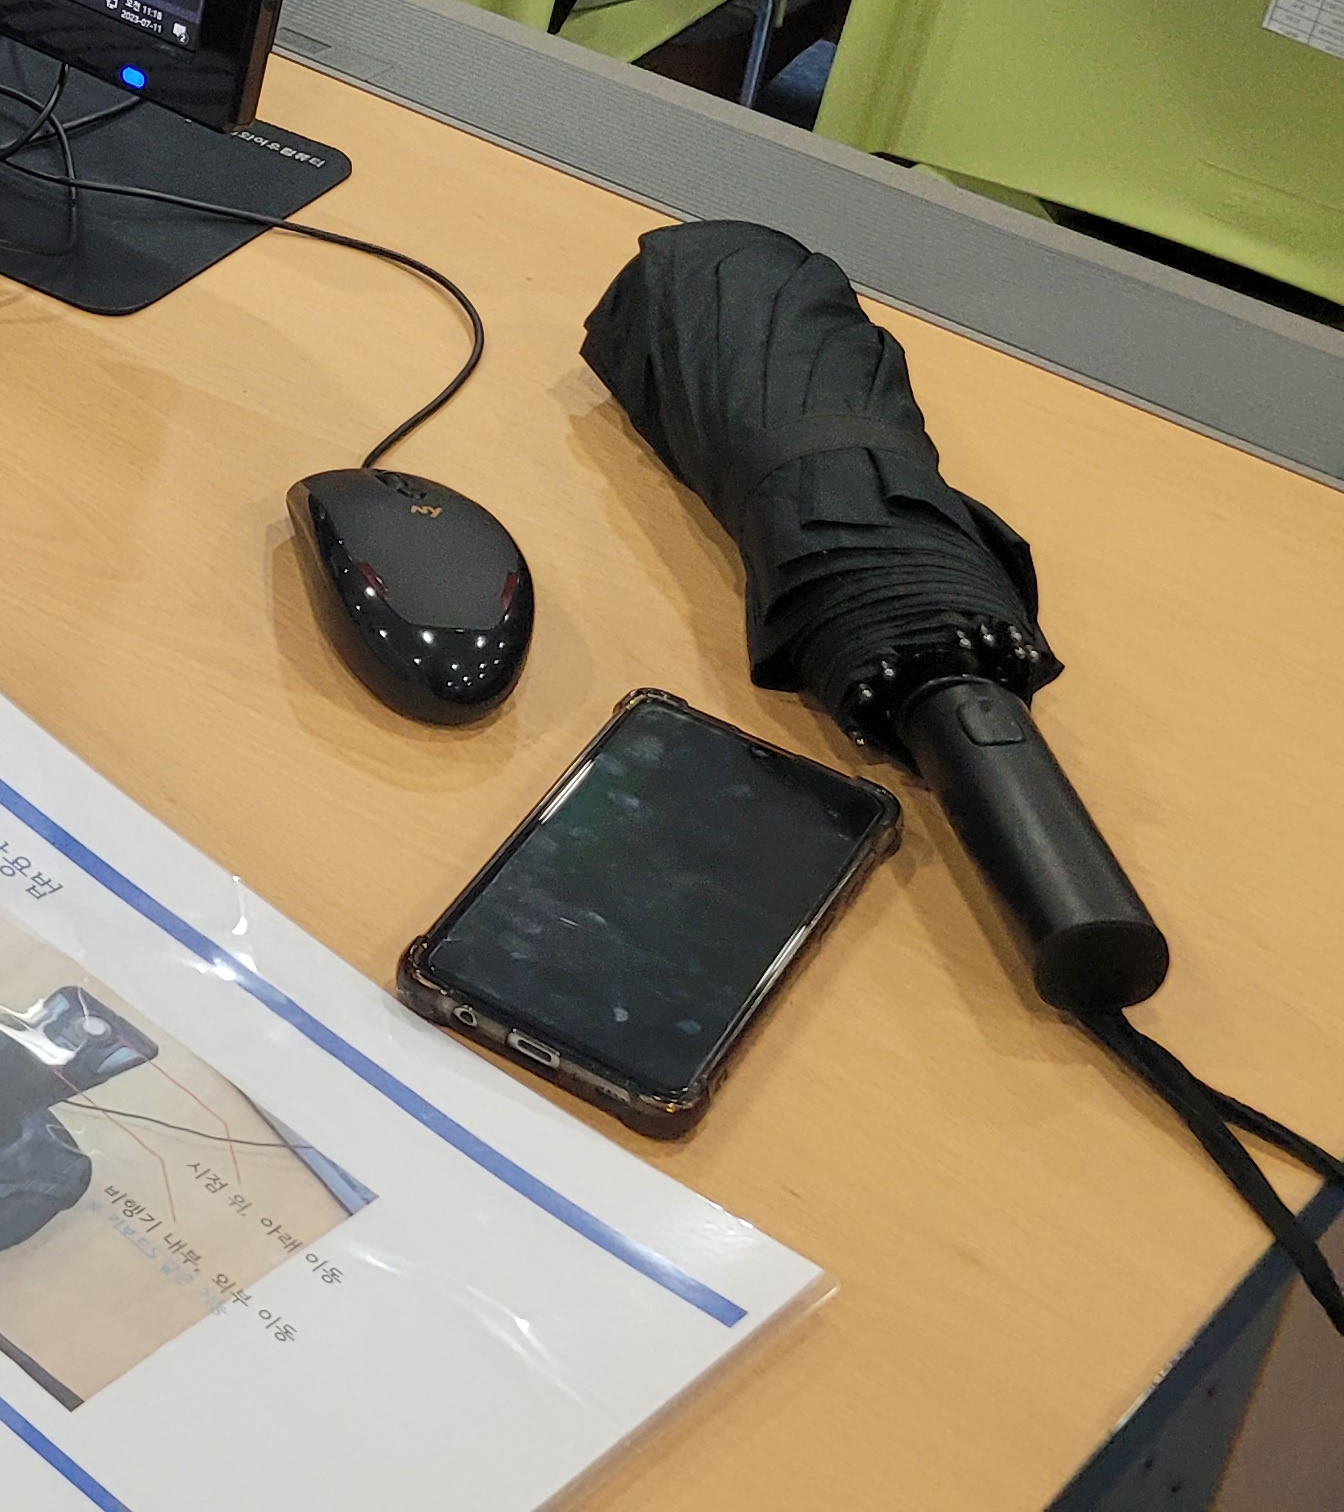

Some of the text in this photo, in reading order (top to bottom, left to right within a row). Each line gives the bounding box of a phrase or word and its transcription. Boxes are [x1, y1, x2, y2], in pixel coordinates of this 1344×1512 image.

[120, 9, 162, 34] 2023-07-11
[231, 129, 326, 169] 와여우컴퓨터
[186, 1161, 229, 1195] 시점
[259, 1217, 304, 1254] 아래
[304, 1252, 346, 1286] 이동
[210, 1272, 254, 1308] 외부
[258, 1308, 299, 1344] 이동
